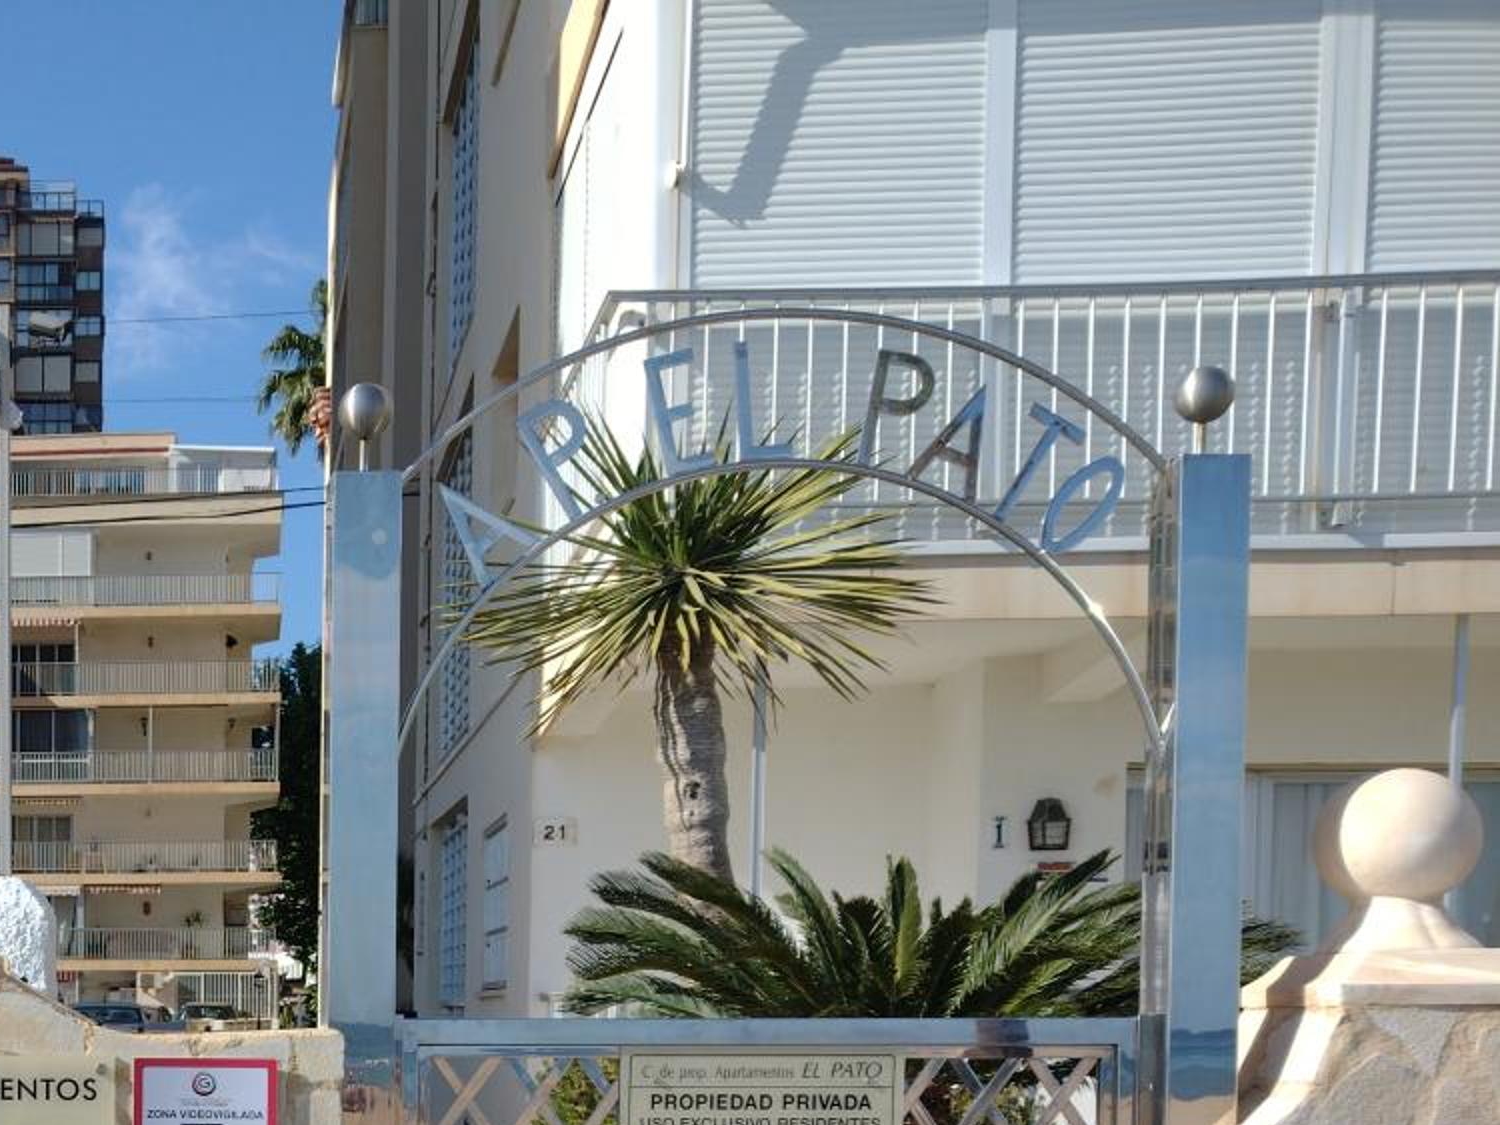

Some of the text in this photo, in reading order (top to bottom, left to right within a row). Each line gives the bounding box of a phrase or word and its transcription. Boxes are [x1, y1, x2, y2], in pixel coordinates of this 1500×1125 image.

[644, 341, 794, 478] EL
[857, 348, 1125, 555] PATO
[543, 824, 565, 841] 21
[802, 1061, 821, 1079] EL
[830, 1061, 883, 1079] PATO
[650, 1093, 872, 1111] PROPIEDAD PRIVADA
[147, 1109, 263, 1120] ZONA VIDEOVIGILADA
